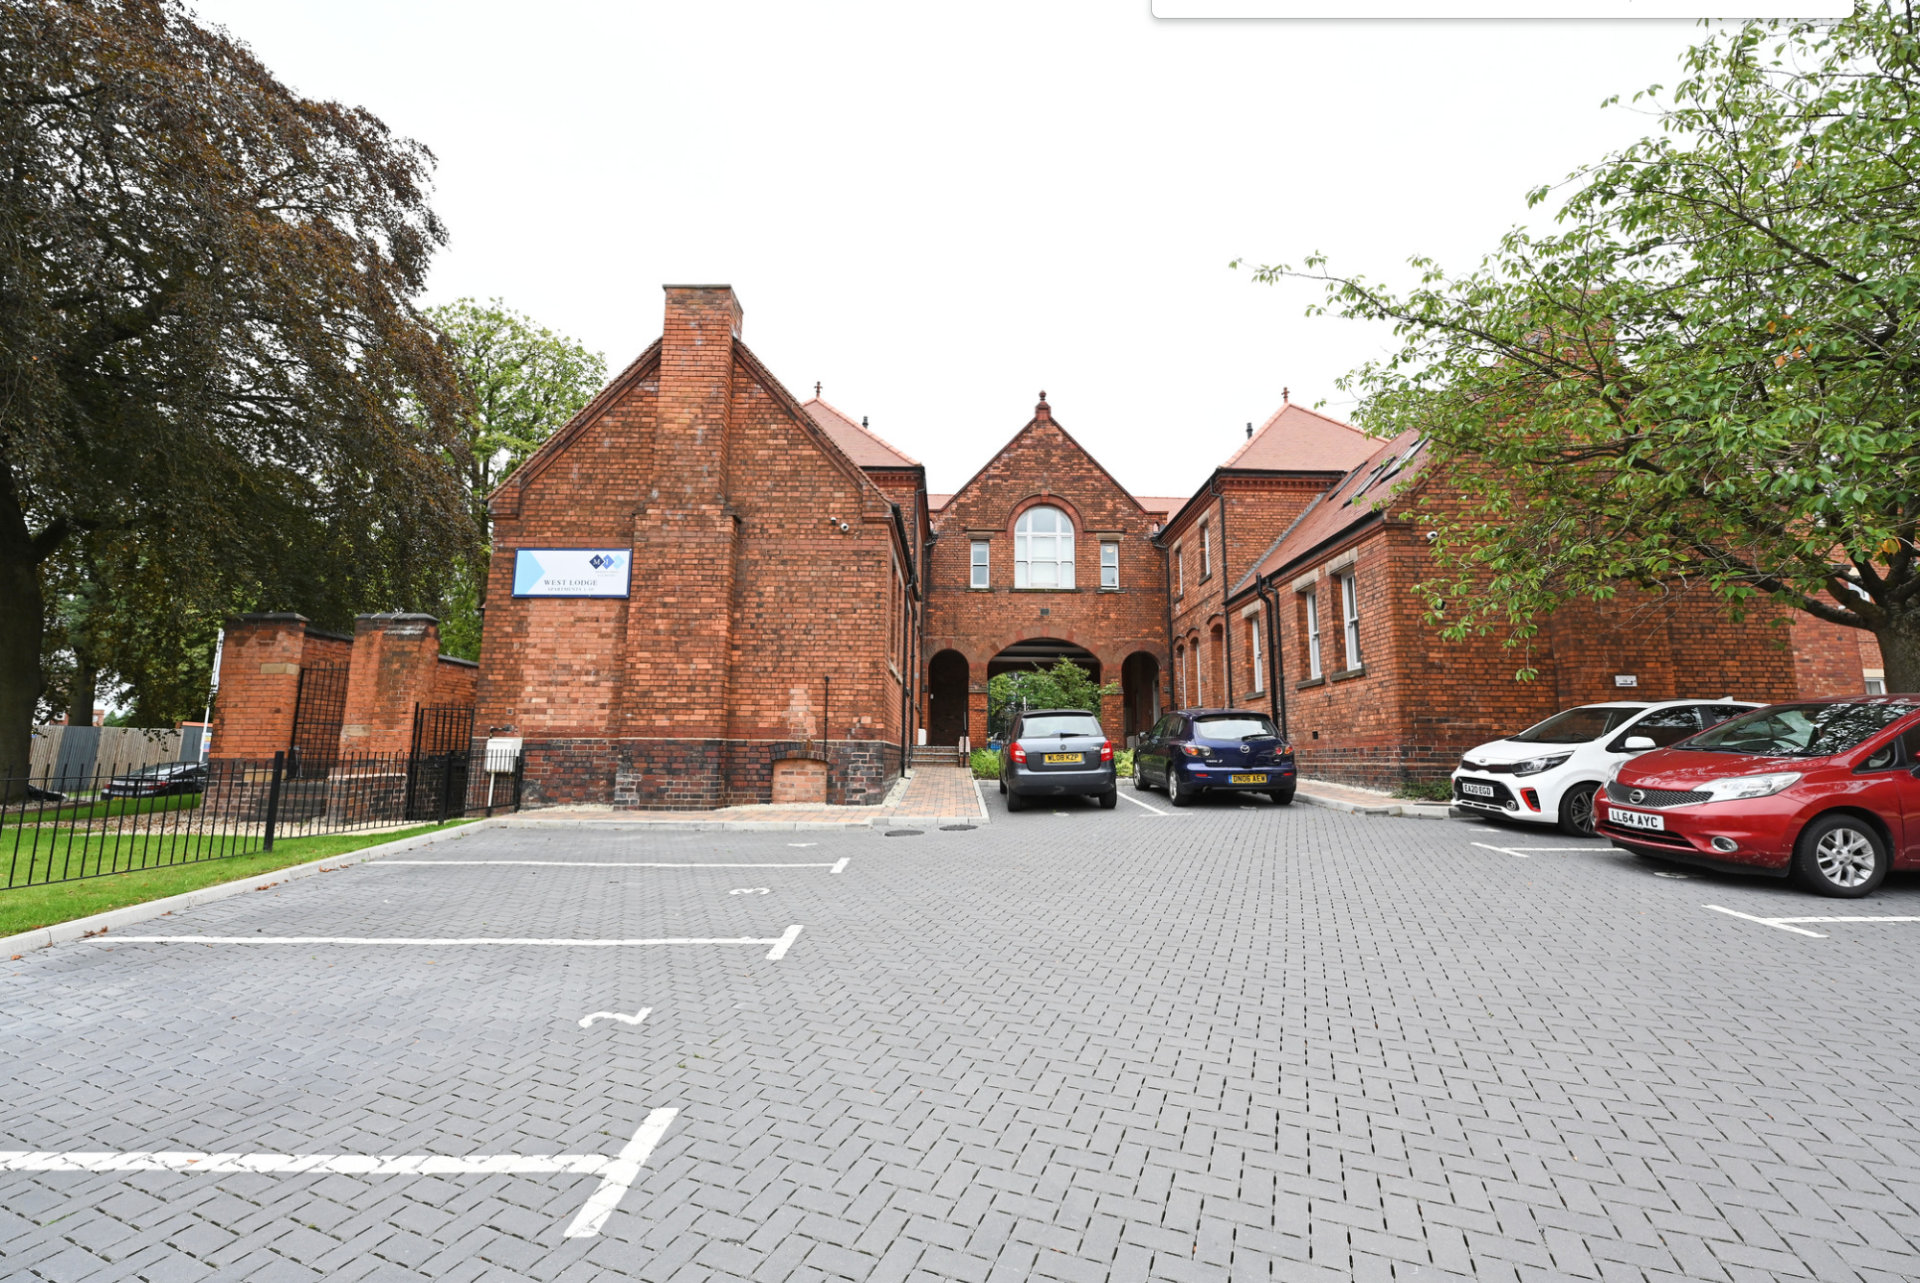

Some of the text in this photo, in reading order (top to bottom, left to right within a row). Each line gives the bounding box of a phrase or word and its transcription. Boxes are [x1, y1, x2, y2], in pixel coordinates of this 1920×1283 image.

[1066, 753, 1079, 761] KZP
[1464, 784, 1479, 794] EA20
[1611, 810, 1658, 828] LL64 AYC
[728, 887, 771, 896] 3
[578, 1006, 654, 1029] 2
